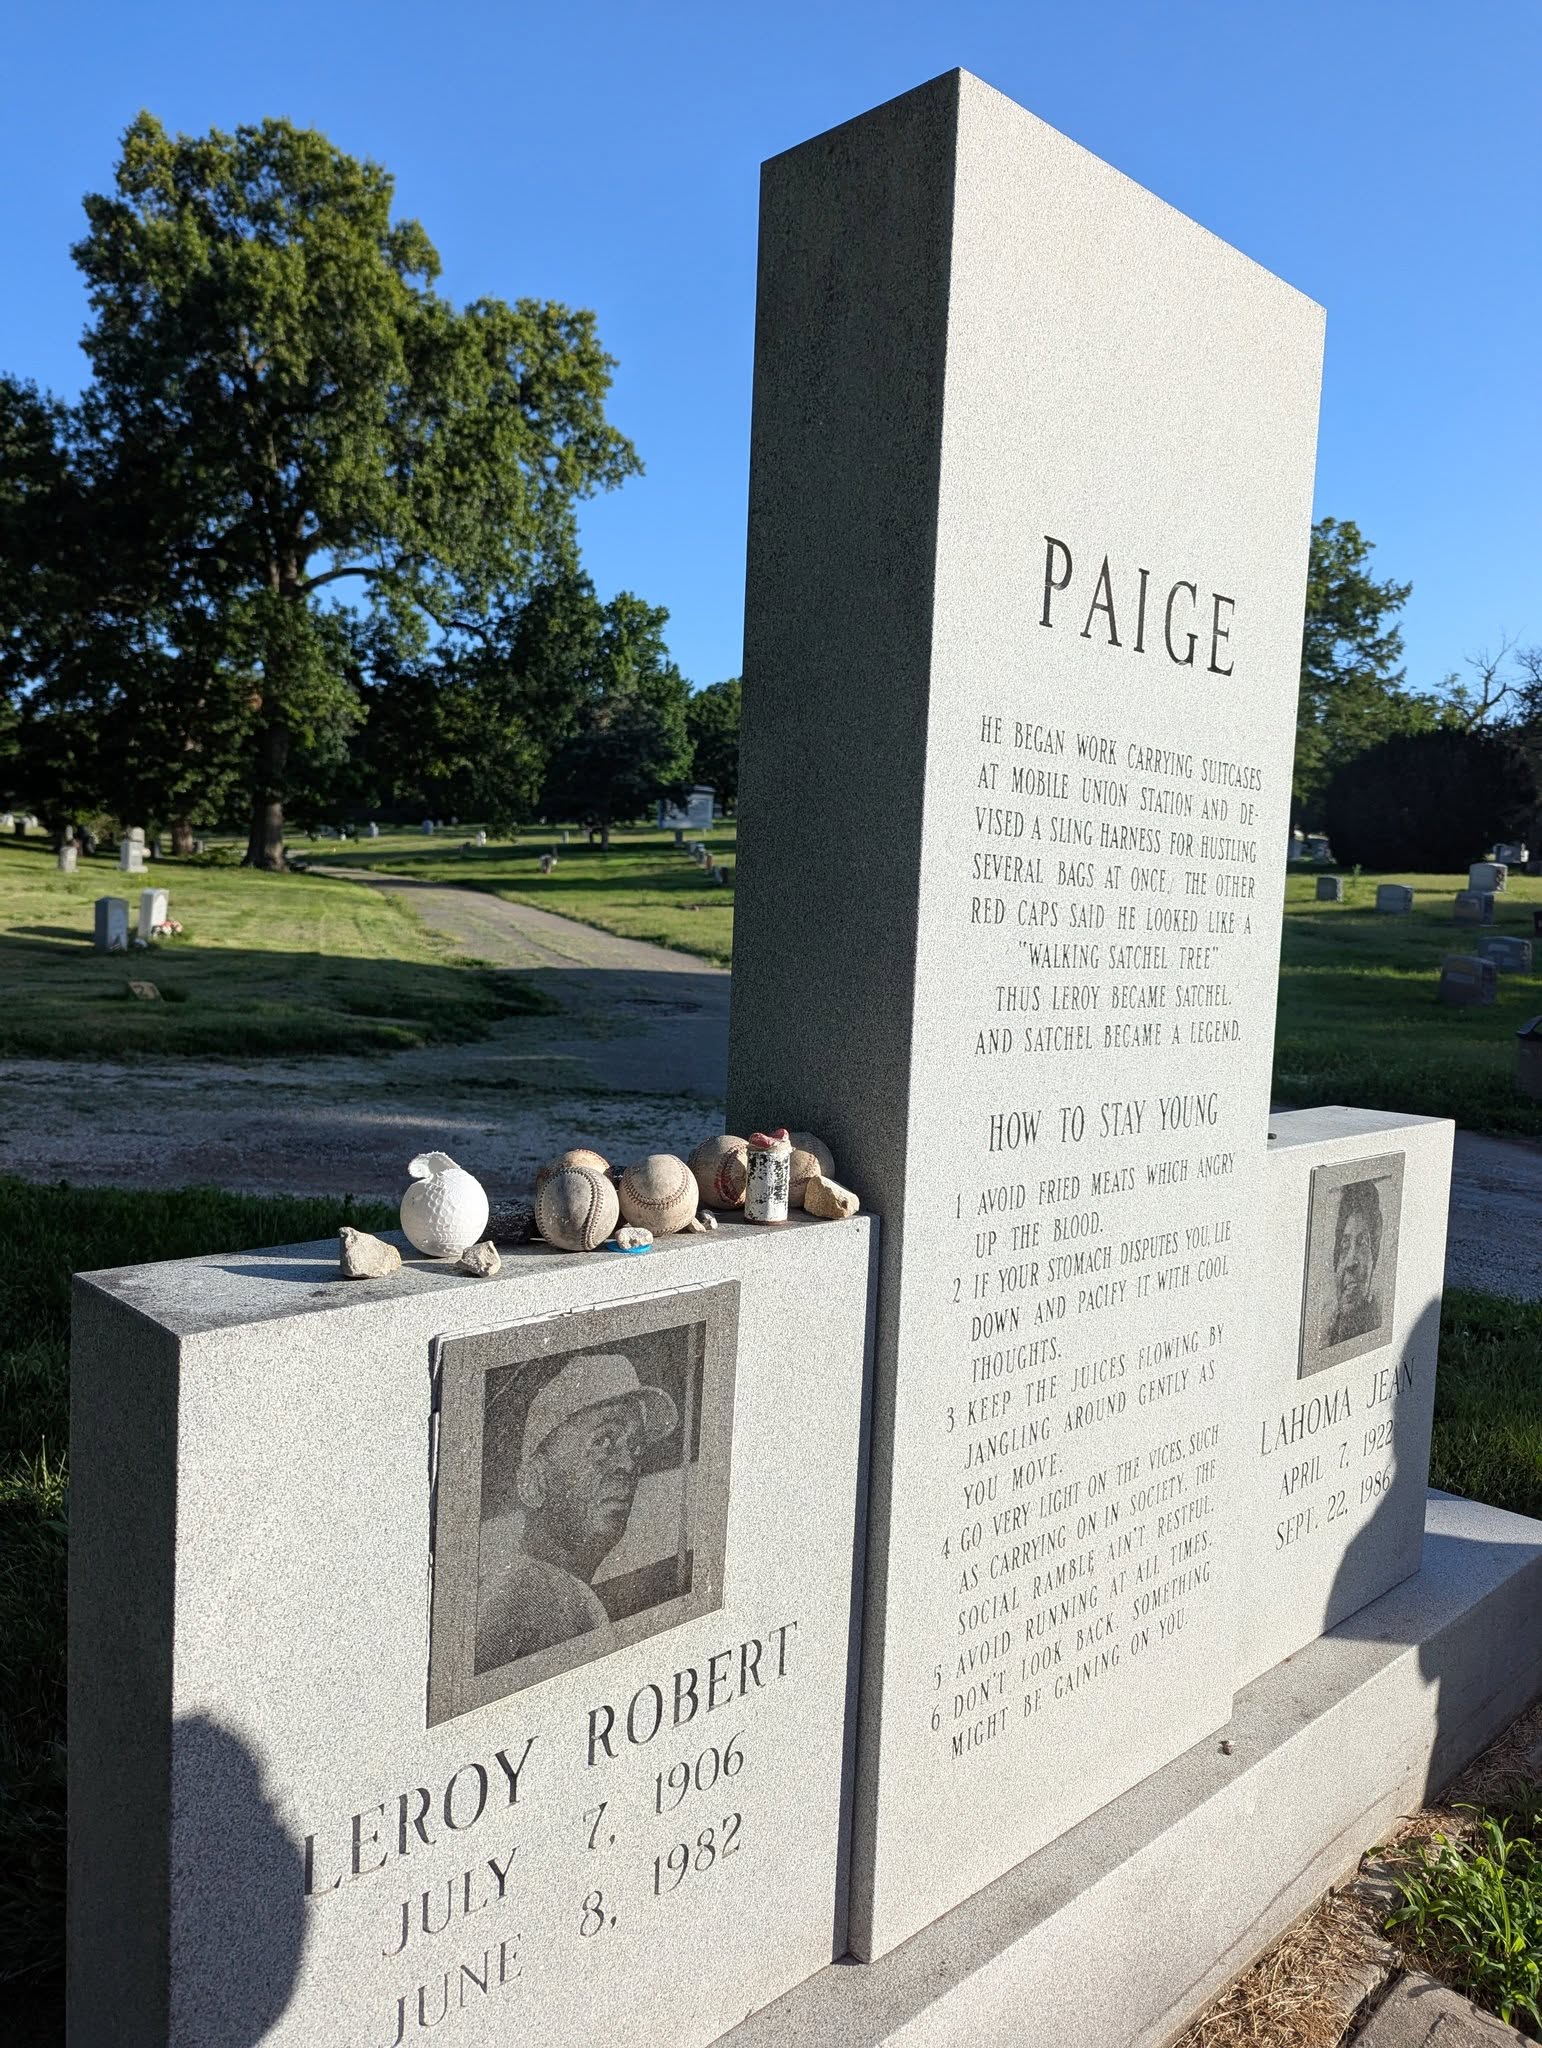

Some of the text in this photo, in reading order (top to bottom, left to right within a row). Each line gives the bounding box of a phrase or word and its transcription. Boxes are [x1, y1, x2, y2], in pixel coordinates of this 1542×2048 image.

[1039, 535, 1235, 676] PAIGE
[977, 763, 1259, 826] AT MOBILE UNION STATION AND DE-
[980, 715, 1262, 791] HE BEGAN WORK CARRYING SUITCASES
[973, 853, 1044, 884] SEVERAL
[1058, 861, 1094, 888] BAGS
[1104, 866, 1122, 889] AT
[1185, 871, 1207, 895] THE
[1216, 874, 1255, 898] OTHER
[975, 807, 1257, 863] VISED A SLING HARNESS FOR HUSTLING
[970, 897, 1252, 934] RED CAPS SAID HE LOOKED LIKE A
[1109, 945, 1167, 969] SATCHEL
[974, 1020, 1241, 1055] AND SATCHEL BECAME A LEGEND.
[996, 984, 1231, 1012] THUS LEROY BECAME SATCHEL.
[989, 1092, 1218, 1151] HOW TO STAY YOUNG
[956, 1152, 1236, 1219] 1 AVOID FRIED MEATS WHICH ANGRY
[953, 1278, 960, 1303] 2
[974, 1273, 989, 1300] IF
[999, 1262, 1039, 1292] YOUR
[1047, 1246, 1112, 1282] STOMACH
[1120, 1231, 1178, 1264] DISPUTES
[1215, 1220, 1231, 1243] LIE
[975, 1211, 1103, 1258] UP THE BLOOD.
[972, 1256, 1228, 1342] DOWN AND PACIFY IT WITH COOL
[946, 1323, 1224, 1433] 3 KEEP THE JUICES FLOWING BY
[972, 1337, 1062, 1384] THOUGHTS.
[964, 1359, 1215, 1469] JANGLING AROUND GENTLY AS
[1260, 1357, 1415, 1456] LAHOMA JEAN
[942, 1536, 950, 1560] 4
[961, 1521, 982, 1553] GO
[993, 1502, 1031, 1537] VERY
[1039, 1481, 1081, 1520] LIGHT
[1088, 1471, 1107, 1498] ON
[1117, 1457, 1139, 1486] THE
[1189, 1424, 1219, 1455] SUCH
[963, 1452, 1063, 1510] YOU MOVE.
[1279, 1455, 1323, 1499] APRIL
[1363, 1419, 1394, 1456] 1922
[959, 1563, 979, 1595] AS
[990, 1525, 1066, 1580] CARRYING
[1077, 1512, 1097, 1540] ON
[1105, 1501, 1119, 1528] IN
[1196, 1459, 1216, 1486] THE
[1275, 1464, 1391, 1551] SEPT. 22, 1986
[958, 1495, 1214, 1636] SOCIAL RAMBLE AIN'T RESTFUL.
[931, 1561, 1210, 1731] 6 DON'T LOOK BACK. SOMETHING
[934, 1530, 1211, 1691] 5 AVOID RUNNING AT ALL TIMES.
[952, 1608, 1188, 1760] MIGHT BE GAINING ON YOU.
[303, 1621, 798, 1896] LEROY ROBERT
[382, 1730, 746, 1958] JULY 7, 1906
[378, 1812, 742, 2048] JUNE 8, 1982
